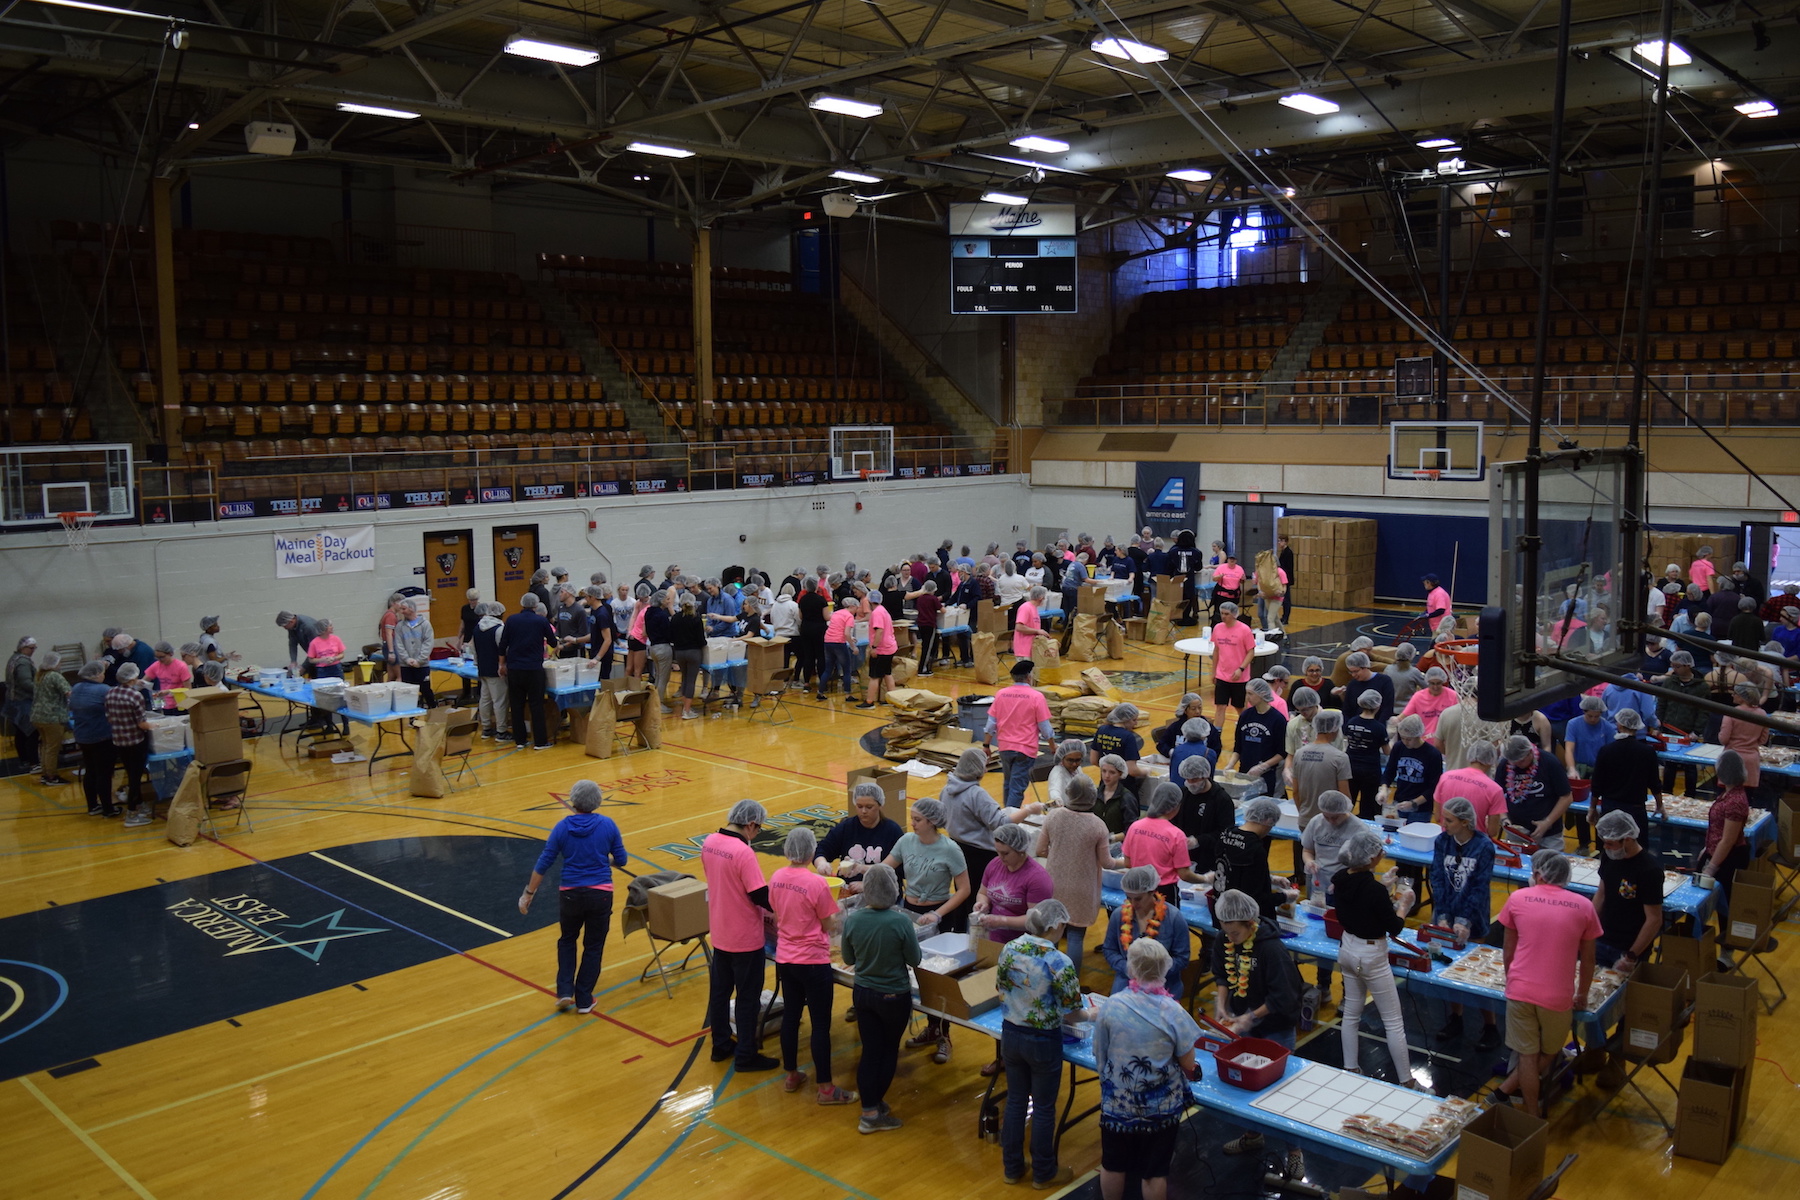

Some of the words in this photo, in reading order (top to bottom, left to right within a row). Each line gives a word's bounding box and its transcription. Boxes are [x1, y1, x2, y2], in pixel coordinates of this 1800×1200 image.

[630, 480, 650, 489] THE
[650, 479, 667, 489] PIT
[742, 475, 759, 484] THE
[482, 487, 512, 501] QUIRK
[524, 486, 546, 497] THE
[547, 485, 565, 495] PIT
[593, 483, 619, 494] QUIRK
[270, 500, 298, 512] THE
[301, 497, 323, 509] PIT
[404, 492, 429, 504] THE
[219, 502, 254, 516] QUIRK
[276, 538, 316, 550] Maine
[324, 536, 347, 549] Day
[285, 550, 316, 564] Meal
[325, 547, 375, 561] Packout
[619, 776, 693, 795] EAST
[1447, 774, 1463, 782] TEAM
[1463, 777, 1488, 789] LEADER
[1147, 830, 1170, 844] LEADER
[713, 847, 733, 860] LEADER
[785, 883, 808, 895] LEADER
[210, 893, 290, 927] EAST
[1524, 896, 1546, 904] TEAM
[1547, 899, 1580, 910] LEADER
[165, 898, 284, 957] AMERICA
